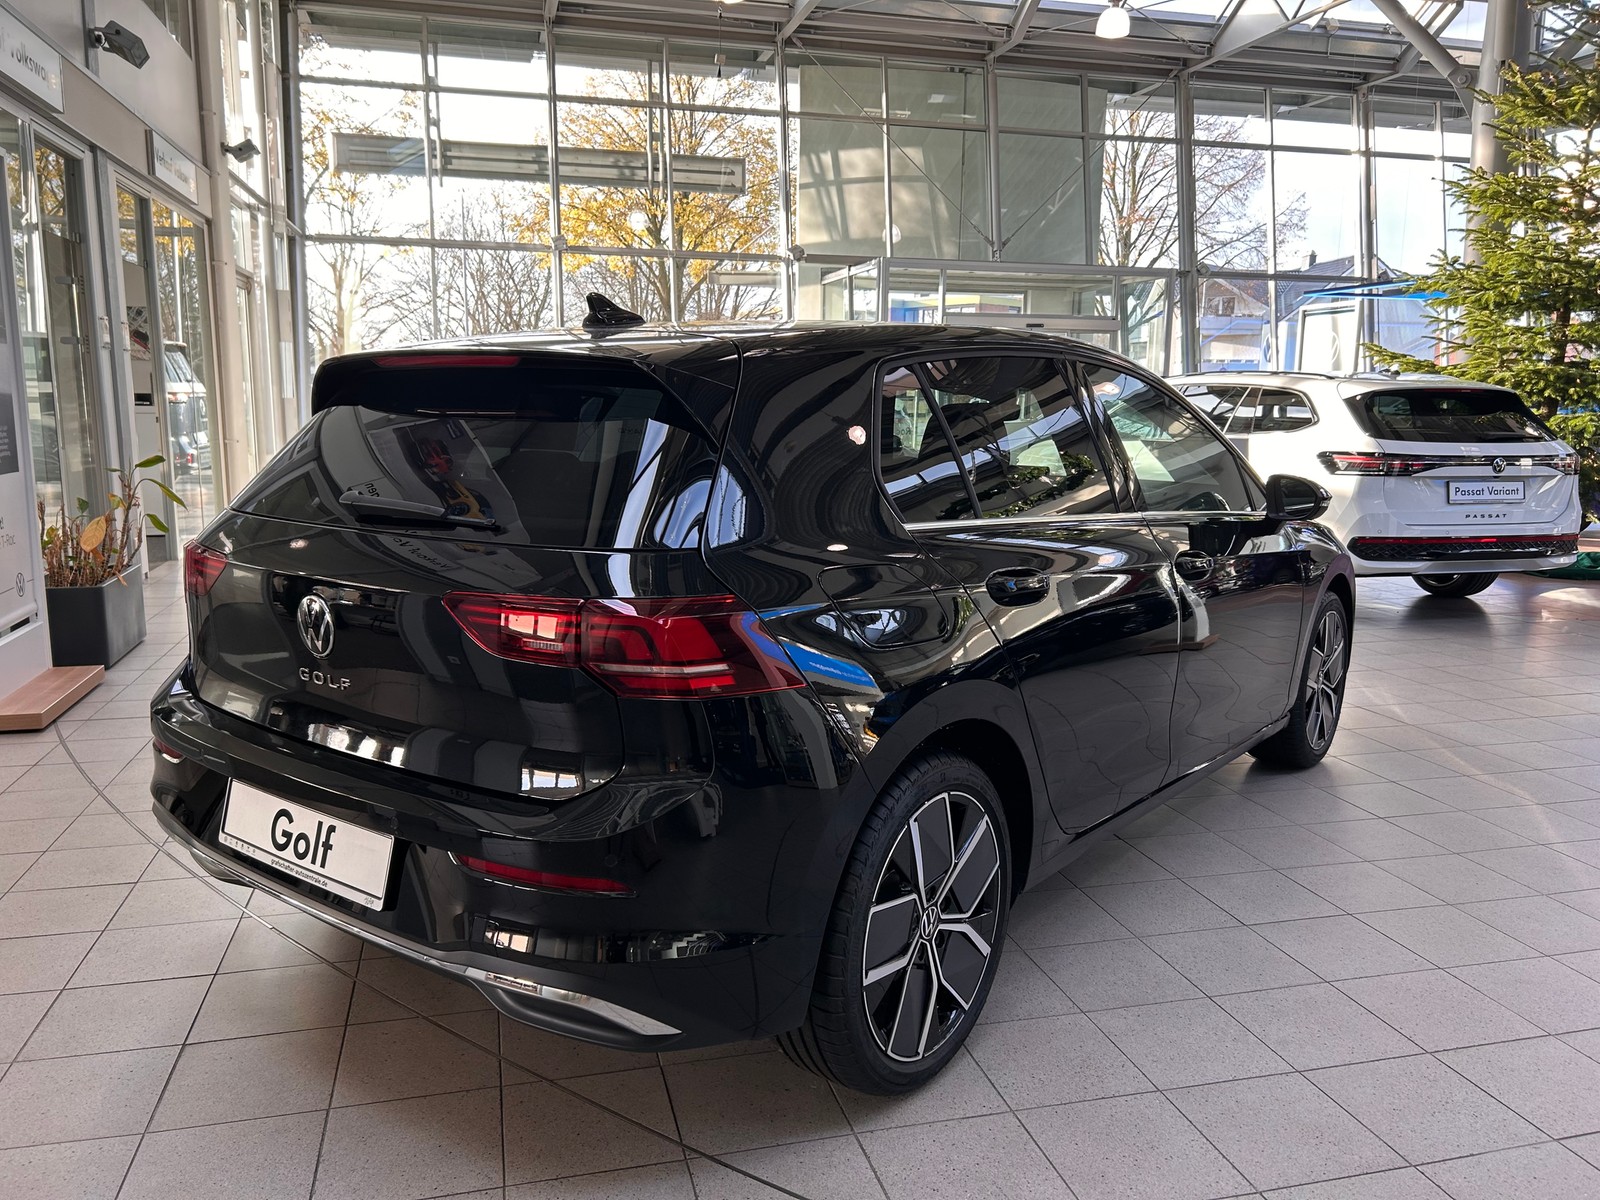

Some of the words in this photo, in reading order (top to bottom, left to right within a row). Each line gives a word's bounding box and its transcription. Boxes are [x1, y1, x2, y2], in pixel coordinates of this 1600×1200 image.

[1454, 486, 1485, 496] Passat
[1487, 486, 1520, 496] Variant
[299, 666, 351, 691] GOLF
[270, 808, 337, 869] Golf
